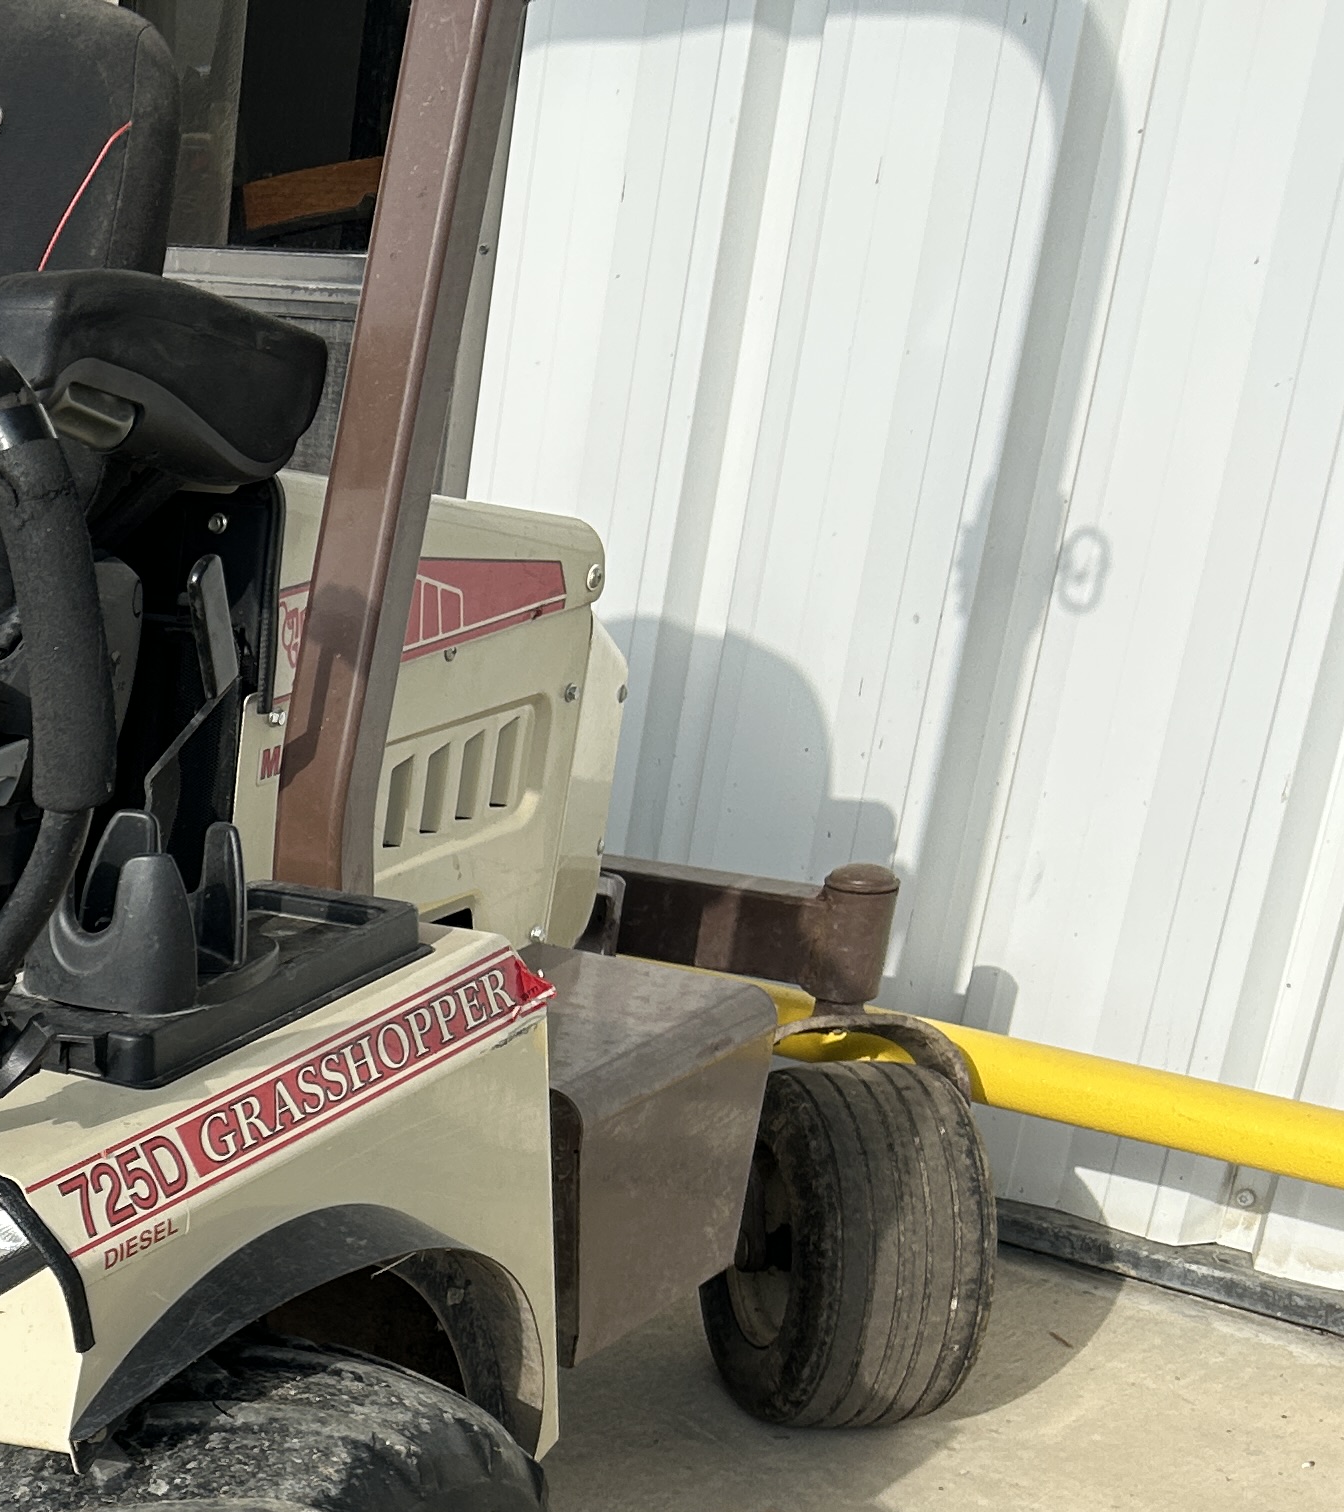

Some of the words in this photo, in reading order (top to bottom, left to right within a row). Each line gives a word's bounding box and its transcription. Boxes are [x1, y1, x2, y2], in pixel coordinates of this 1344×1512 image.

[57, 1135, 188, 1238] 725D
[198, 969, 516, 1165] GRASSHOPPER
[103, 1219, 179, 1270] DIESEL
